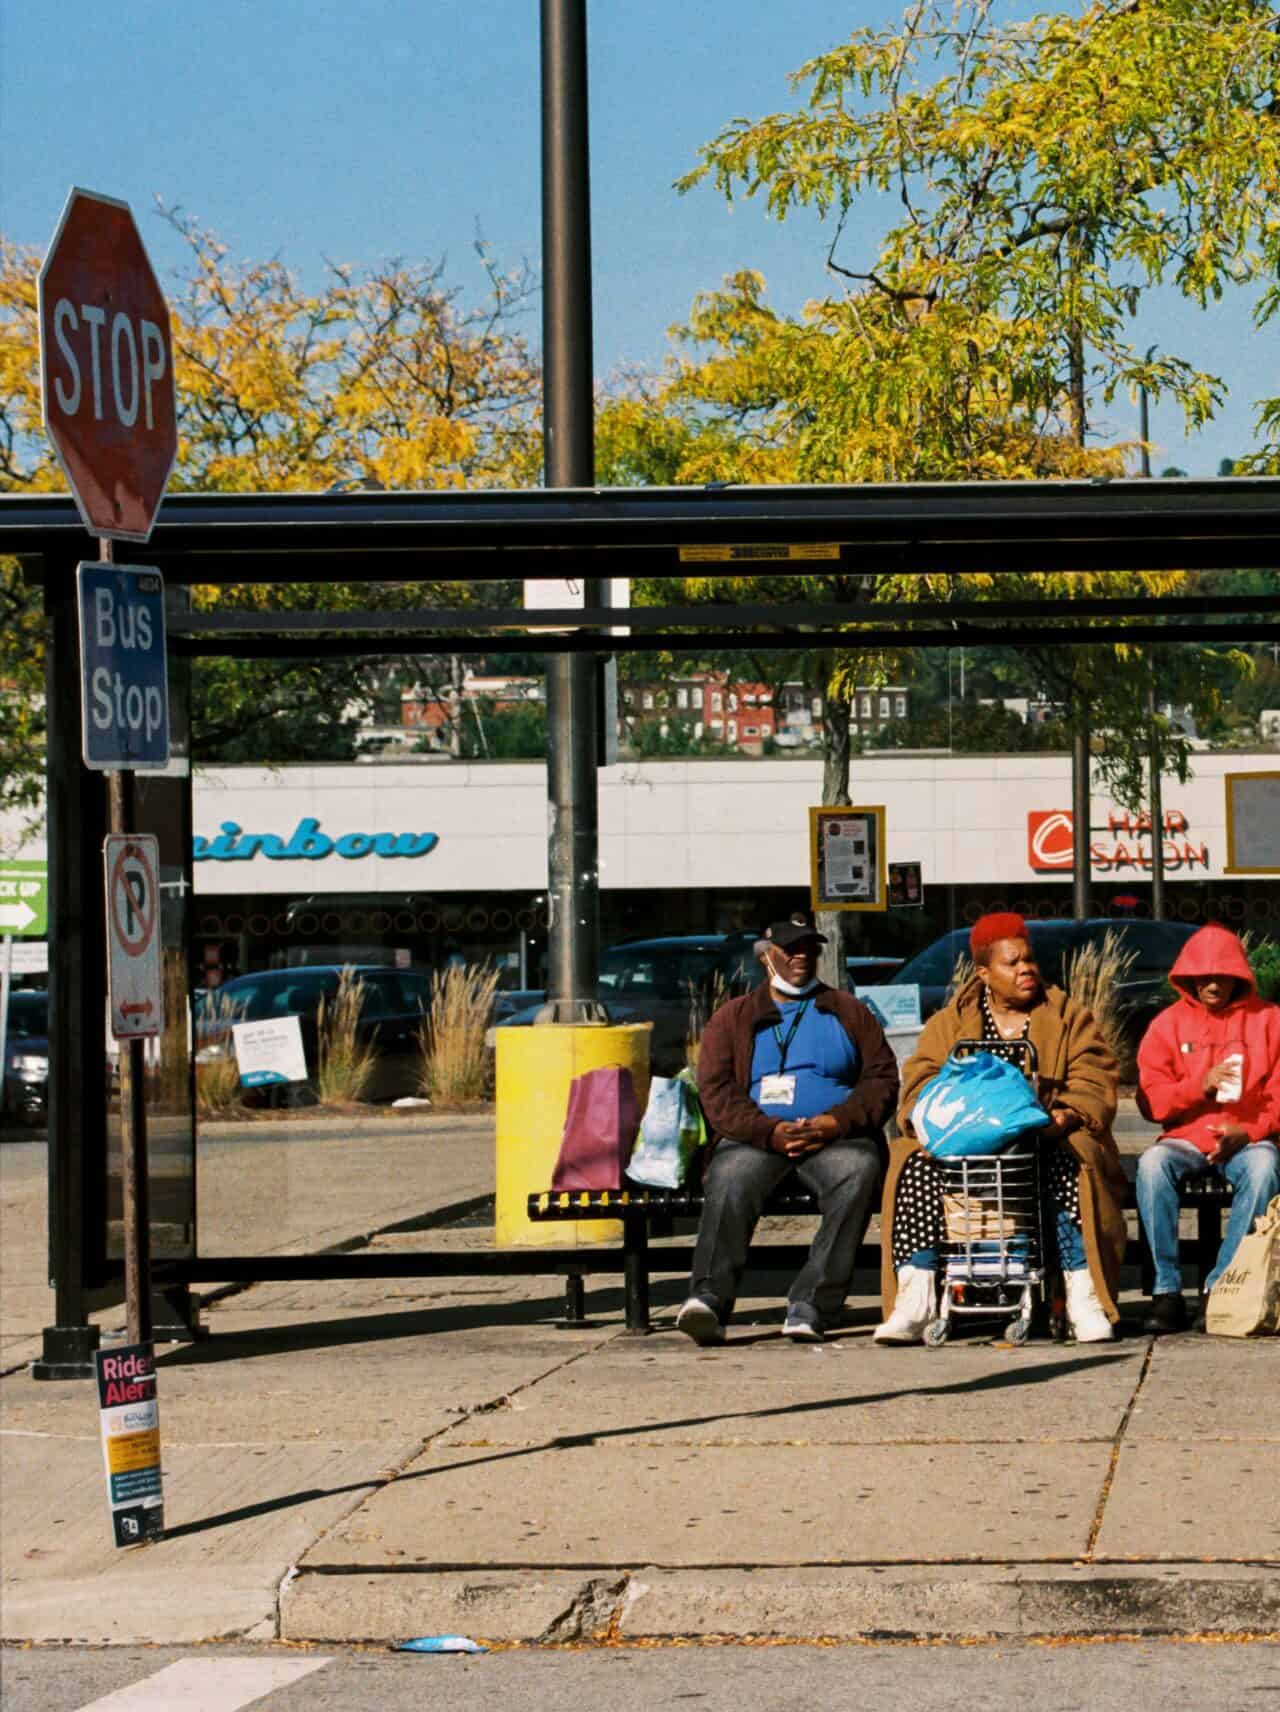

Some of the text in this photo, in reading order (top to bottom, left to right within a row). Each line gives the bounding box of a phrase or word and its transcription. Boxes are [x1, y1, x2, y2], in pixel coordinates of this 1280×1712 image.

[54, 297, 166, 431] STOP
[95, 587, 152, 650] Bus
[92, 667, 163, 742] Stop
[1108, 809, 1185, 834] HAR
